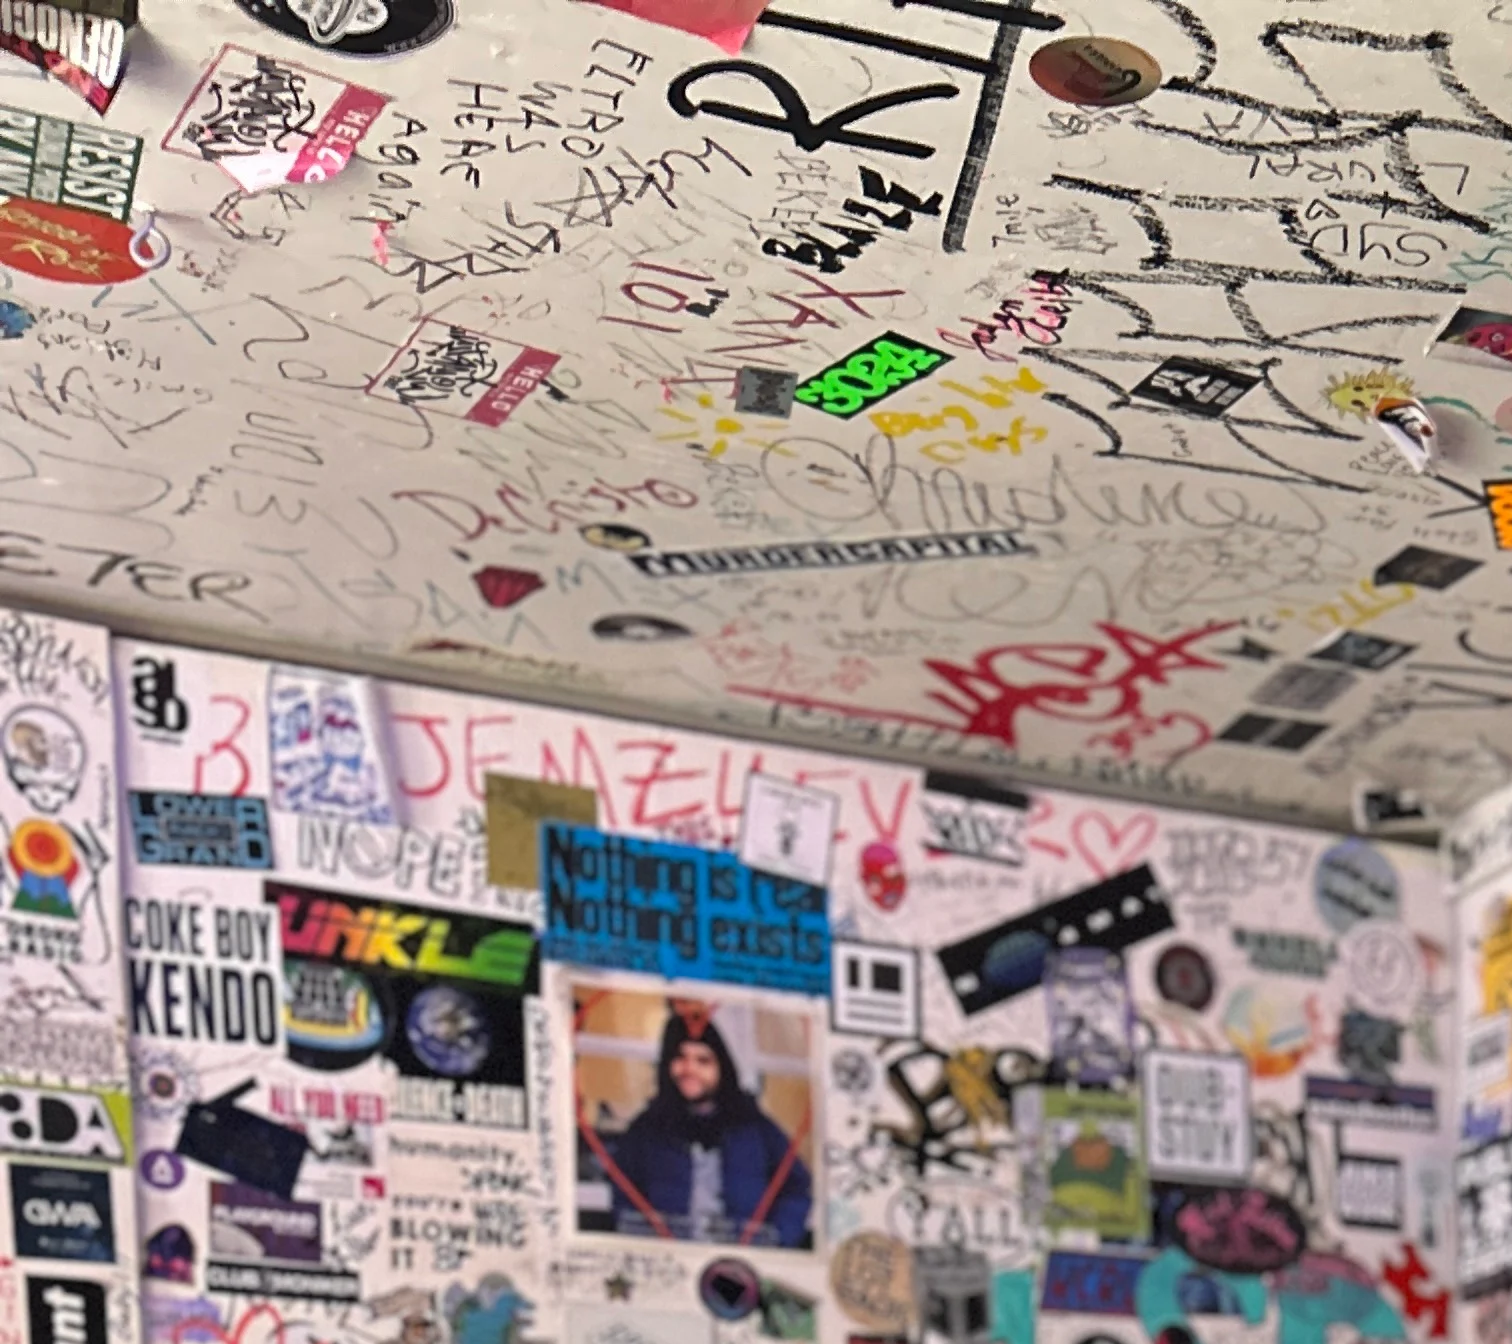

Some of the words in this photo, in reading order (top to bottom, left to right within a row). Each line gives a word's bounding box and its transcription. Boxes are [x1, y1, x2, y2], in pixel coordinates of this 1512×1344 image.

[503, 80, 566, 155] WAS
[794, 338, 945, 412] 3024
[128, 900, 204, 951] COKE
[214, 902, 272, 961] BOY
[276, 894, 536, 985] UNKLE
[131, 958, 276, 1045] KENDO
